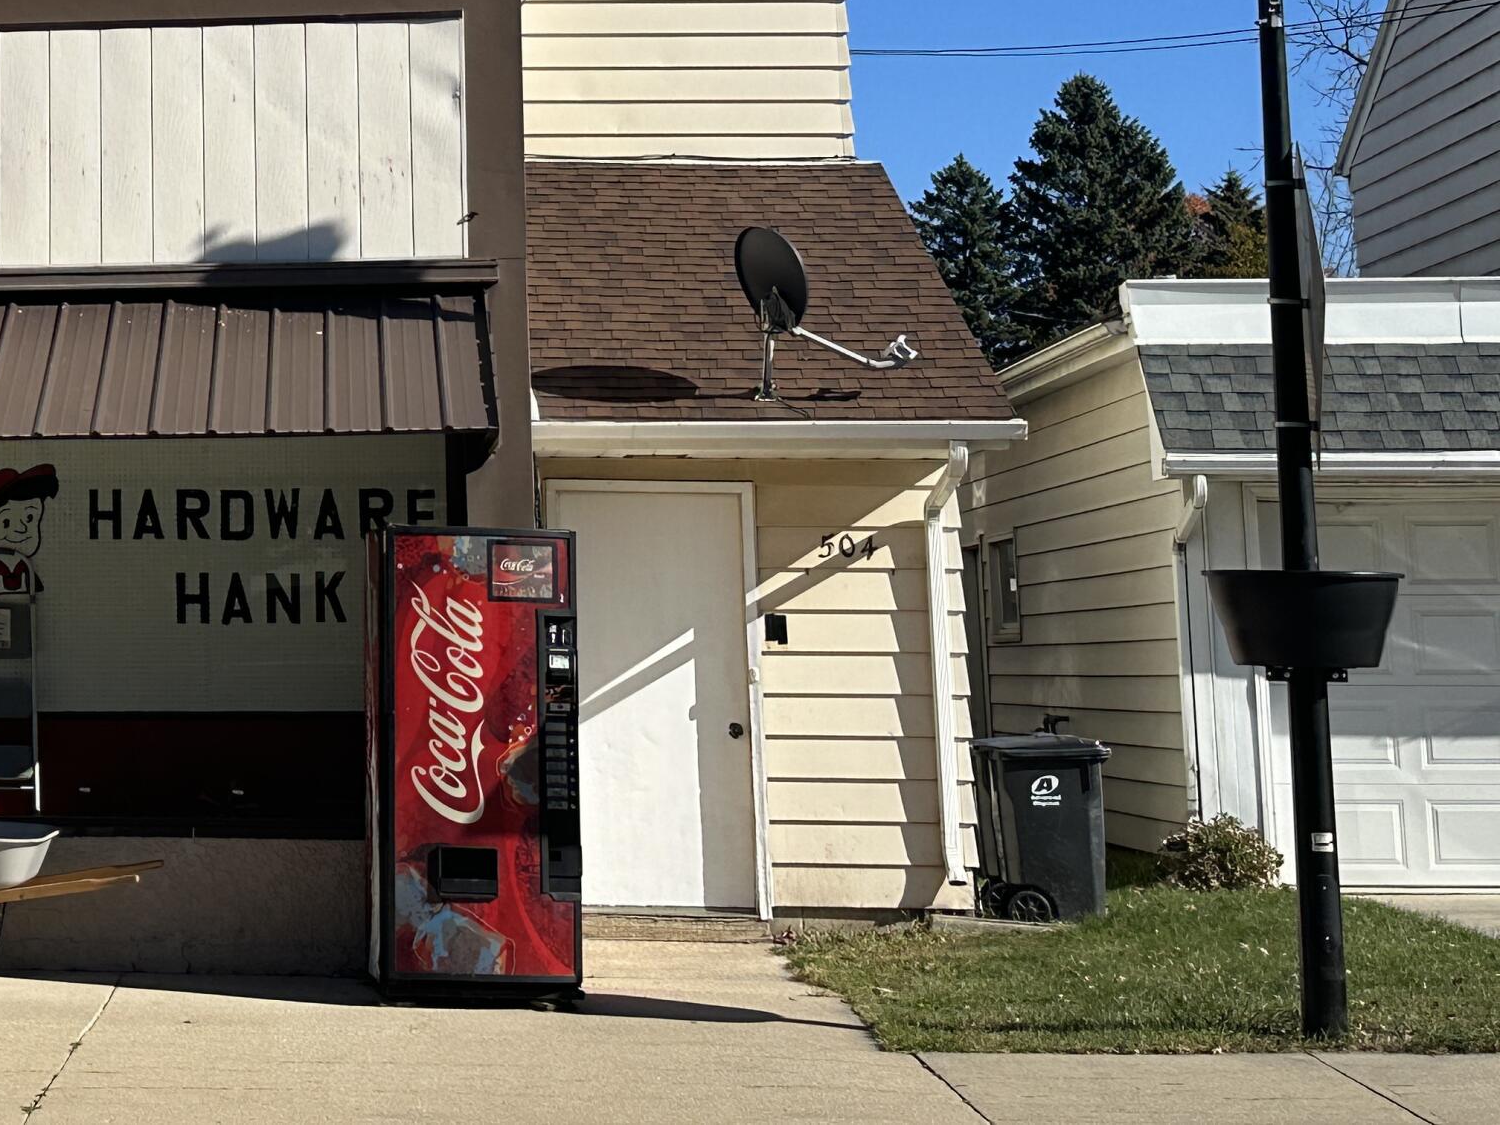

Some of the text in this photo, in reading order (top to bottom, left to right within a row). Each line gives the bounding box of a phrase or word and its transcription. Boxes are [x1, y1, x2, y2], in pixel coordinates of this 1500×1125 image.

[88, 488, 436, 541] HARDWARE
[818, 533, 879, 561] 504
[176, 570, 348, 625] HANK
[410, 580, 485, 825] Coca-Cola
